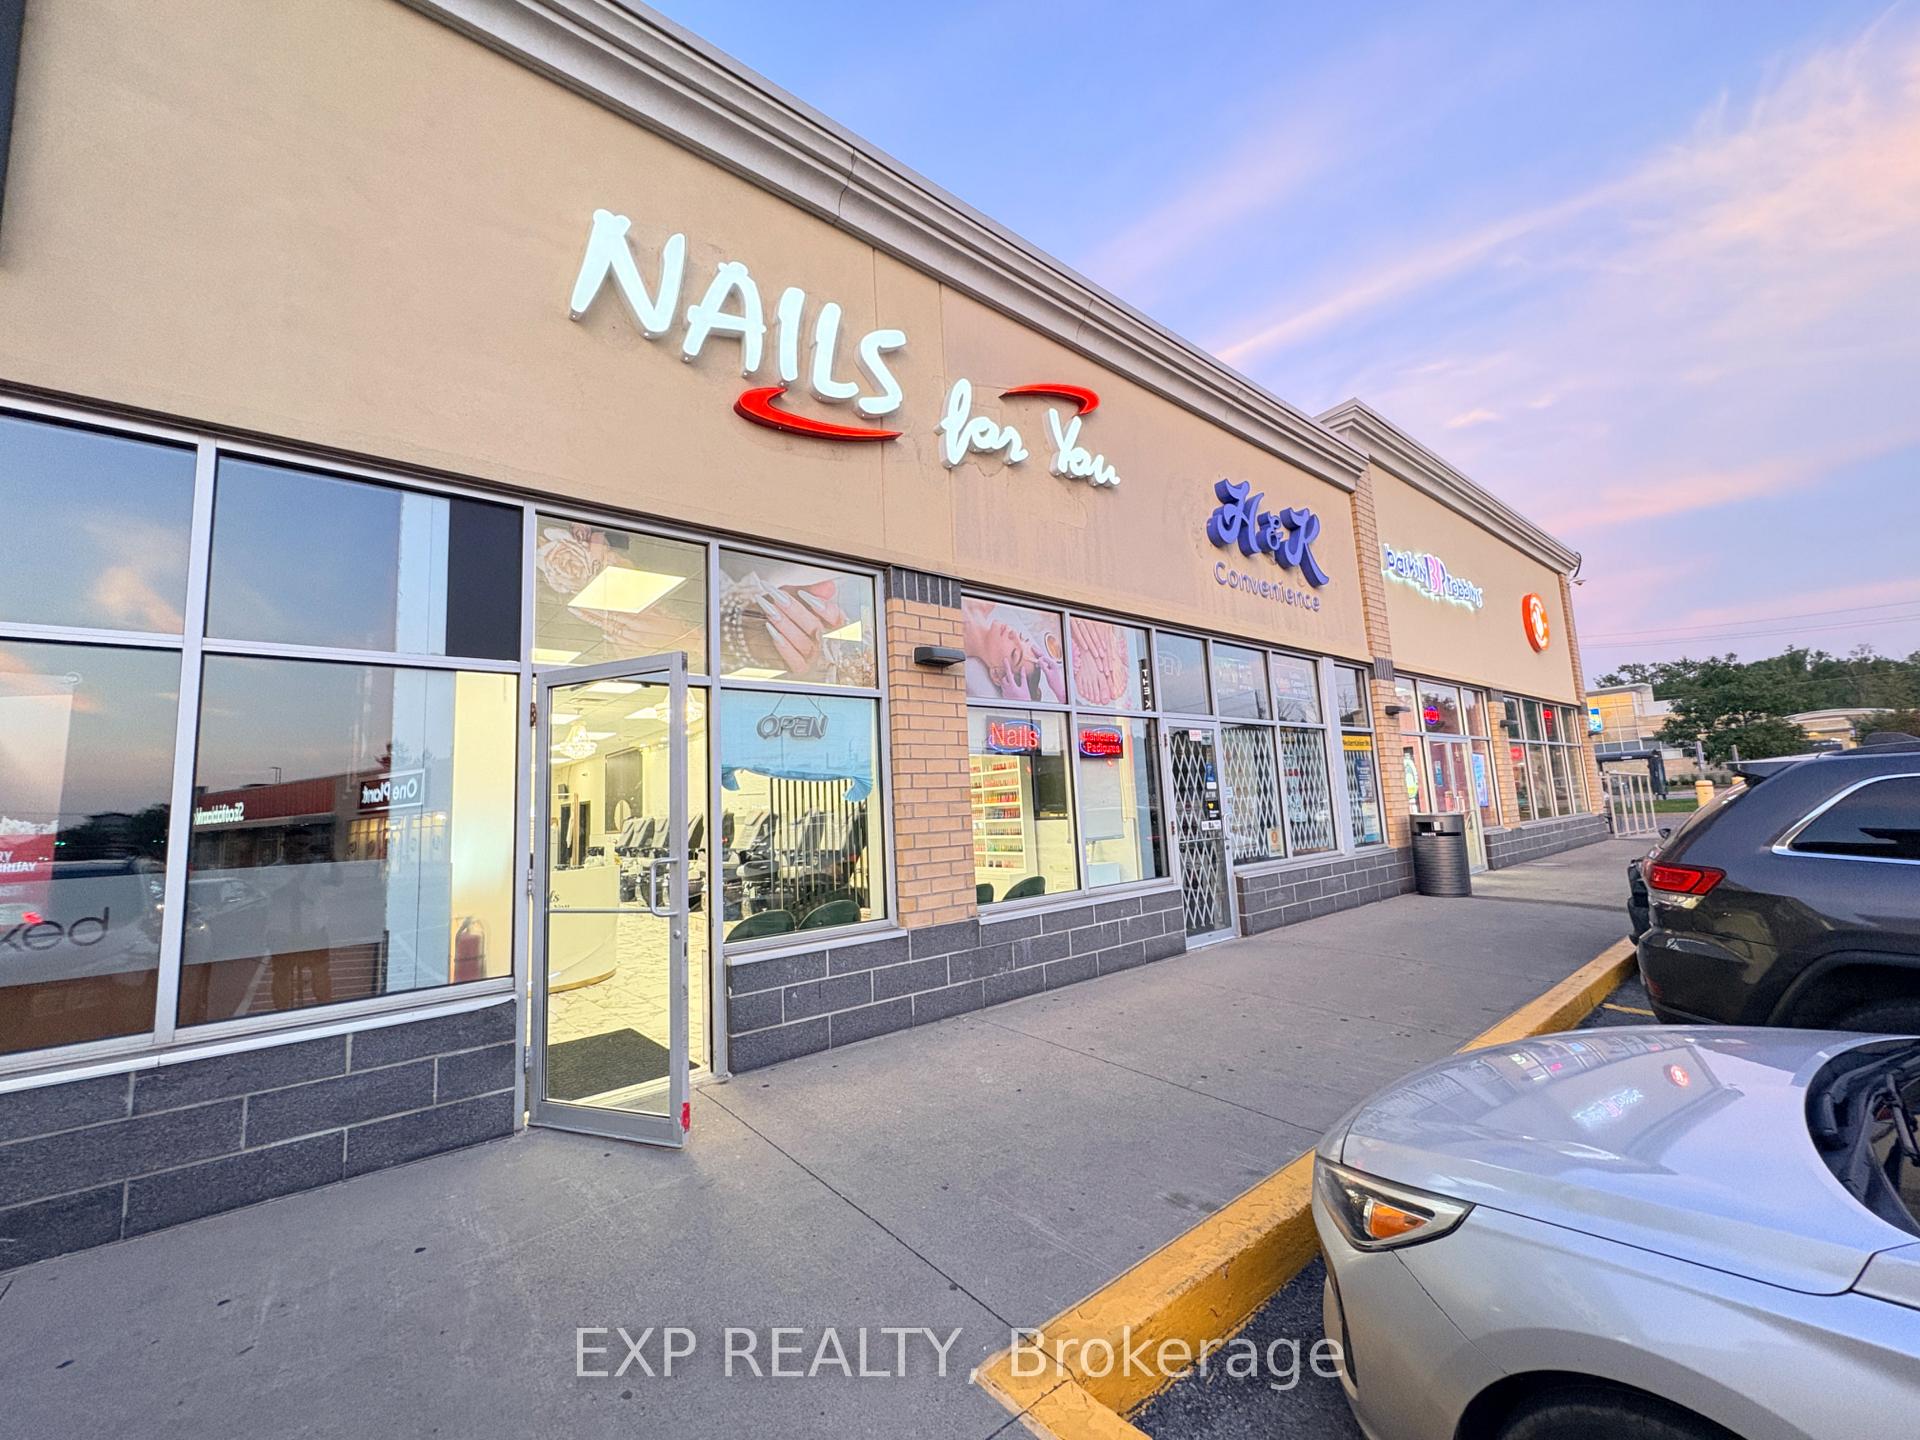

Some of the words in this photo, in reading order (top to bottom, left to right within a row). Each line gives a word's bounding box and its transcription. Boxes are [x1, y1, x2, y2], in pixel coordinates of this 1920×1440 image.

[569, 208, 908, 419] NAILS
[935, 378, 1029, 470] for
[1043, 407, 1121, 488] You
[1213, 561, 1320, 612] Convenience
[757, 713, 829, 739] OPEN
[991, 722, 1038, 748] Nails
